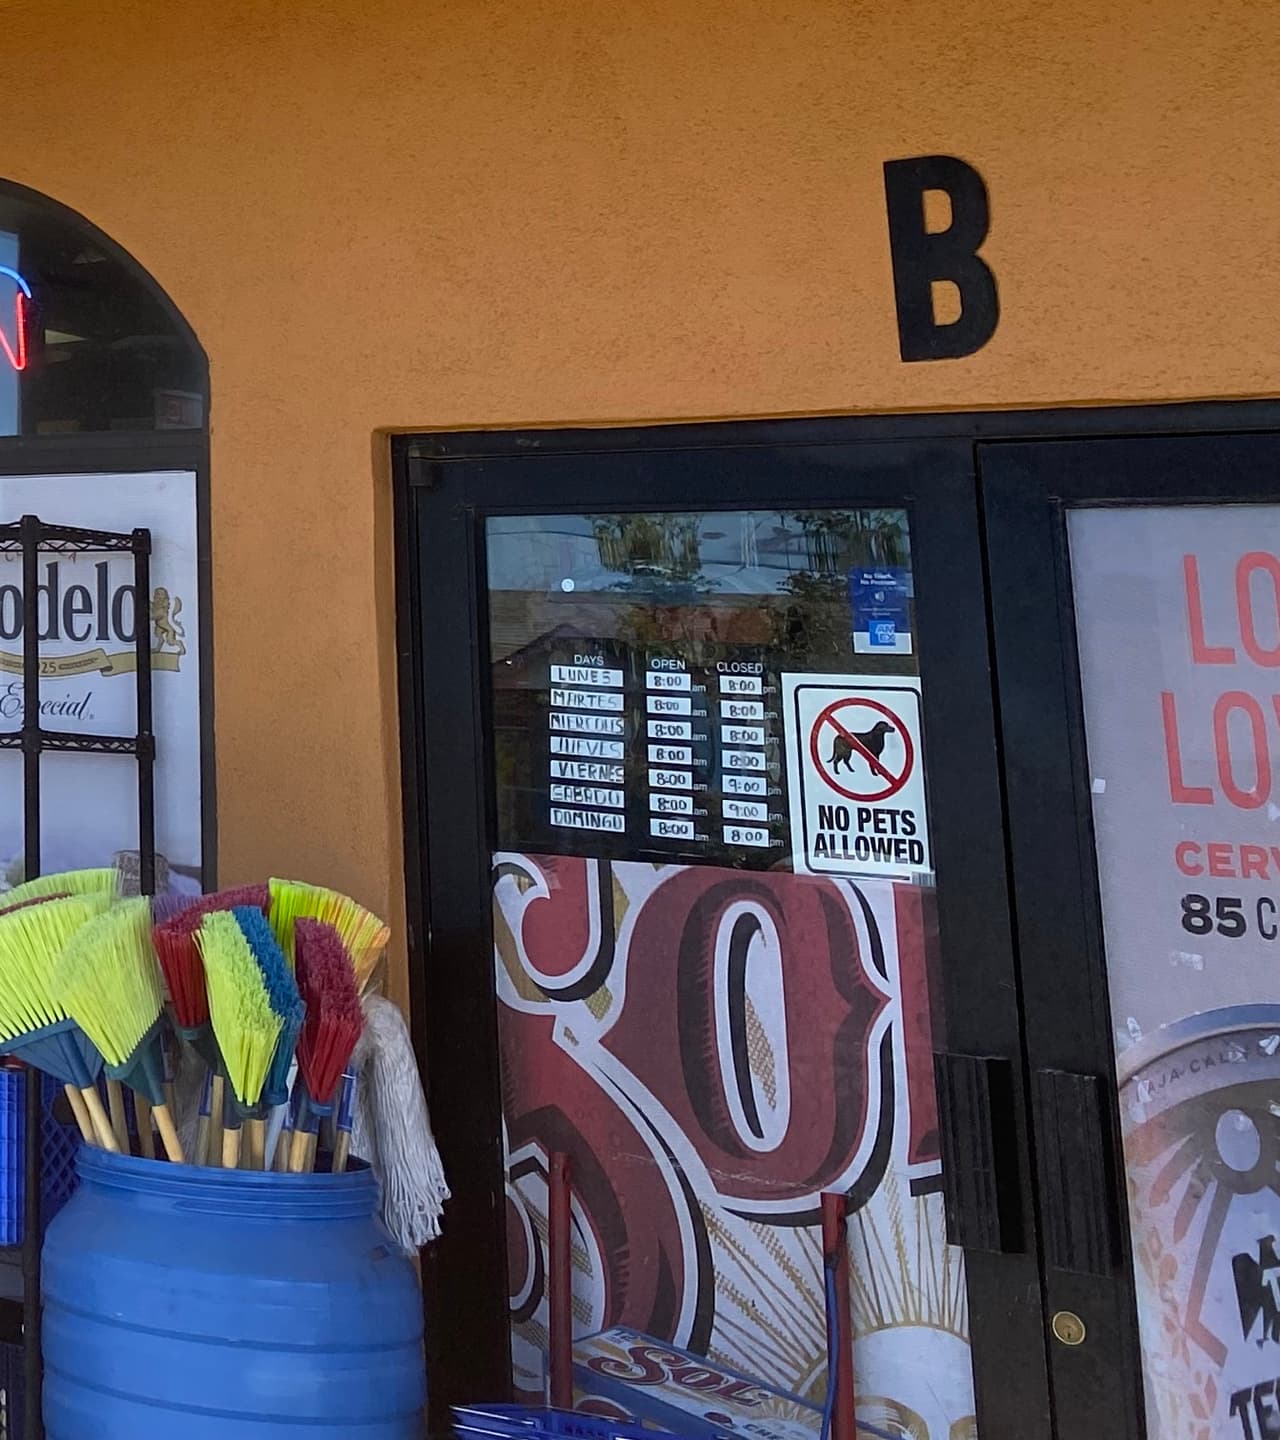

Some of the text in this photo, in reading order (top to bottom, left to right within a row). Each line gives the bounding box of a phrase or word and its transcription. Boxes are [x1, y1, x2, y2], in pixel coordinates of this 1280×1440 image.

[883, 154, 1002, 363] B
[574, 655, 604, 666] DAYS
[651, 659, 686, 670] OPEN
[716, 662, 763, 673] CLOSED
[558, 667, 611, 684] LUNES
[653, 675, 682, 687] 8:00
[728, 679, 777, 695] 8:00 pm
[553, 690, 617, 709] MARTES
[654, 700, 707, 717] 8:00 am
[729, 704, 779, 720] 8:00 pm
[655, 724, 684, 737] 8:00
[729, 730, 779, 746] 8:00 pm
[1161, 690, 1280, 810] LO
[729, 754, 759, 767] 8:00
[558, 762, 624, 782] VIERNES
[656, 773, 708, 791] 8:00 am
[728, 778, 782, 797] 9:00 pm
[657, 797, 708, 816] 8:00 am
[728, 803, 783, 822] 9:00 pm
[818, 805, 916, 836] NO PETS
[658, 822, 709, 841] 8:00 am
[731, 830, 784, 849] 8:00 pm
[814, 835, 924, 865] ALLOWED
[1174, 841, 1280, 880] CER
[1181, 894, 1247, 938] 85
